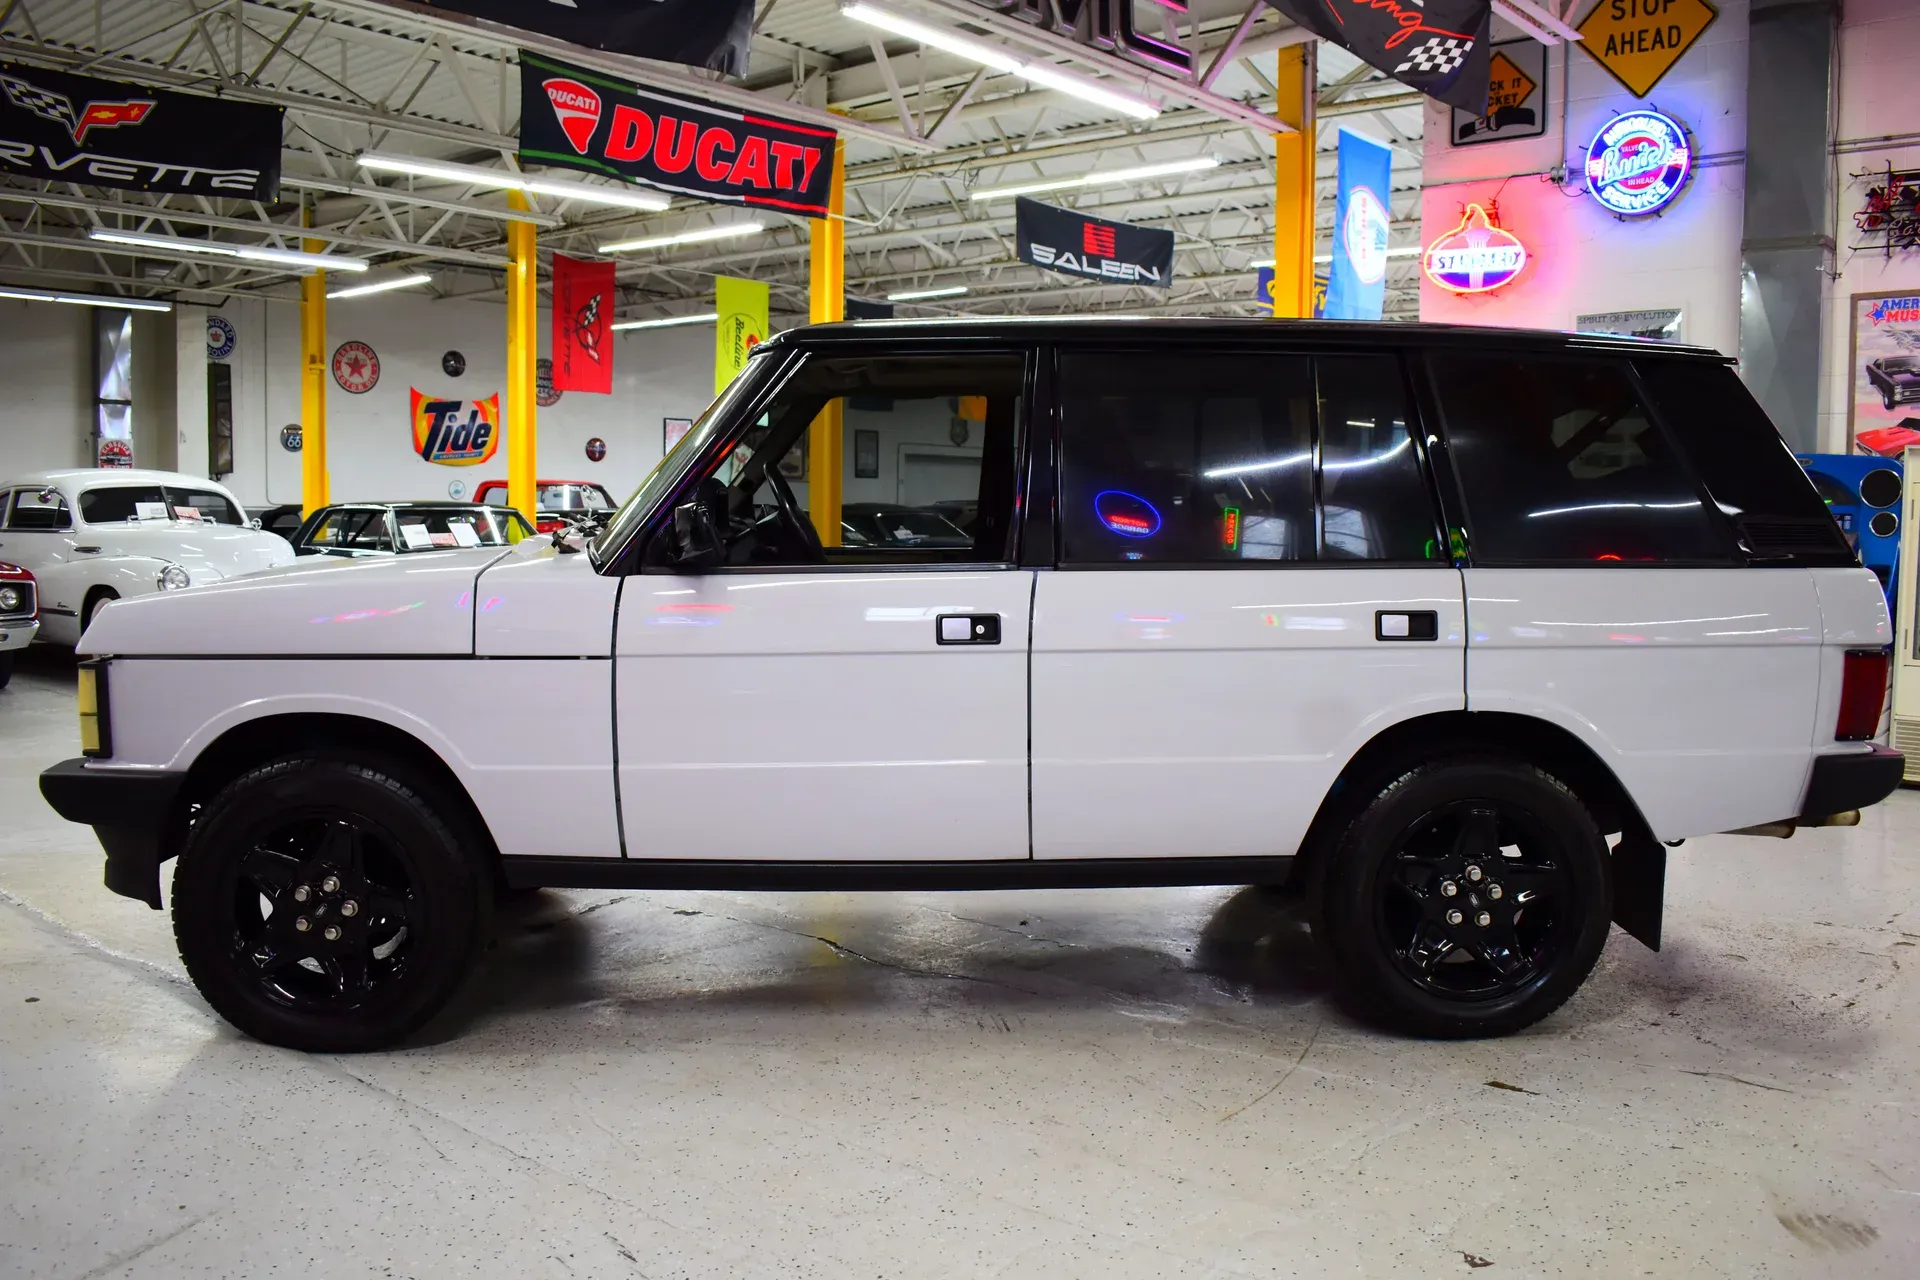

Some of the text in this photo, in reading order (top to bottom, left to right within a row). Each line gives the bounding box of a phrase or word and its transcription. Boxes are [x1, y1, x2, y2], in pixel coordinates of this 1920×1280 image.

[1604, 25, 1682, 57] AHEAD
[1512, 77, 1522, 89] IT
[547, 87, 597, 111] DUCATI
[604, 104, 821, 193] DUCATI
[1621, 143, 1640, 153] VALVE
[1636, 176, 1655, 185] HEAD
[1602, 181, 1670, 209] SERVICE
[1030, 242, 1161, 281] SALEEN
[1577, 310, 1681, 325] SPIRIT OF EVOLUTION
[733, 316, 746, 368] Beeline
[287, 434, 302, 448] 66
[423, 400, 492, 463] Tide
